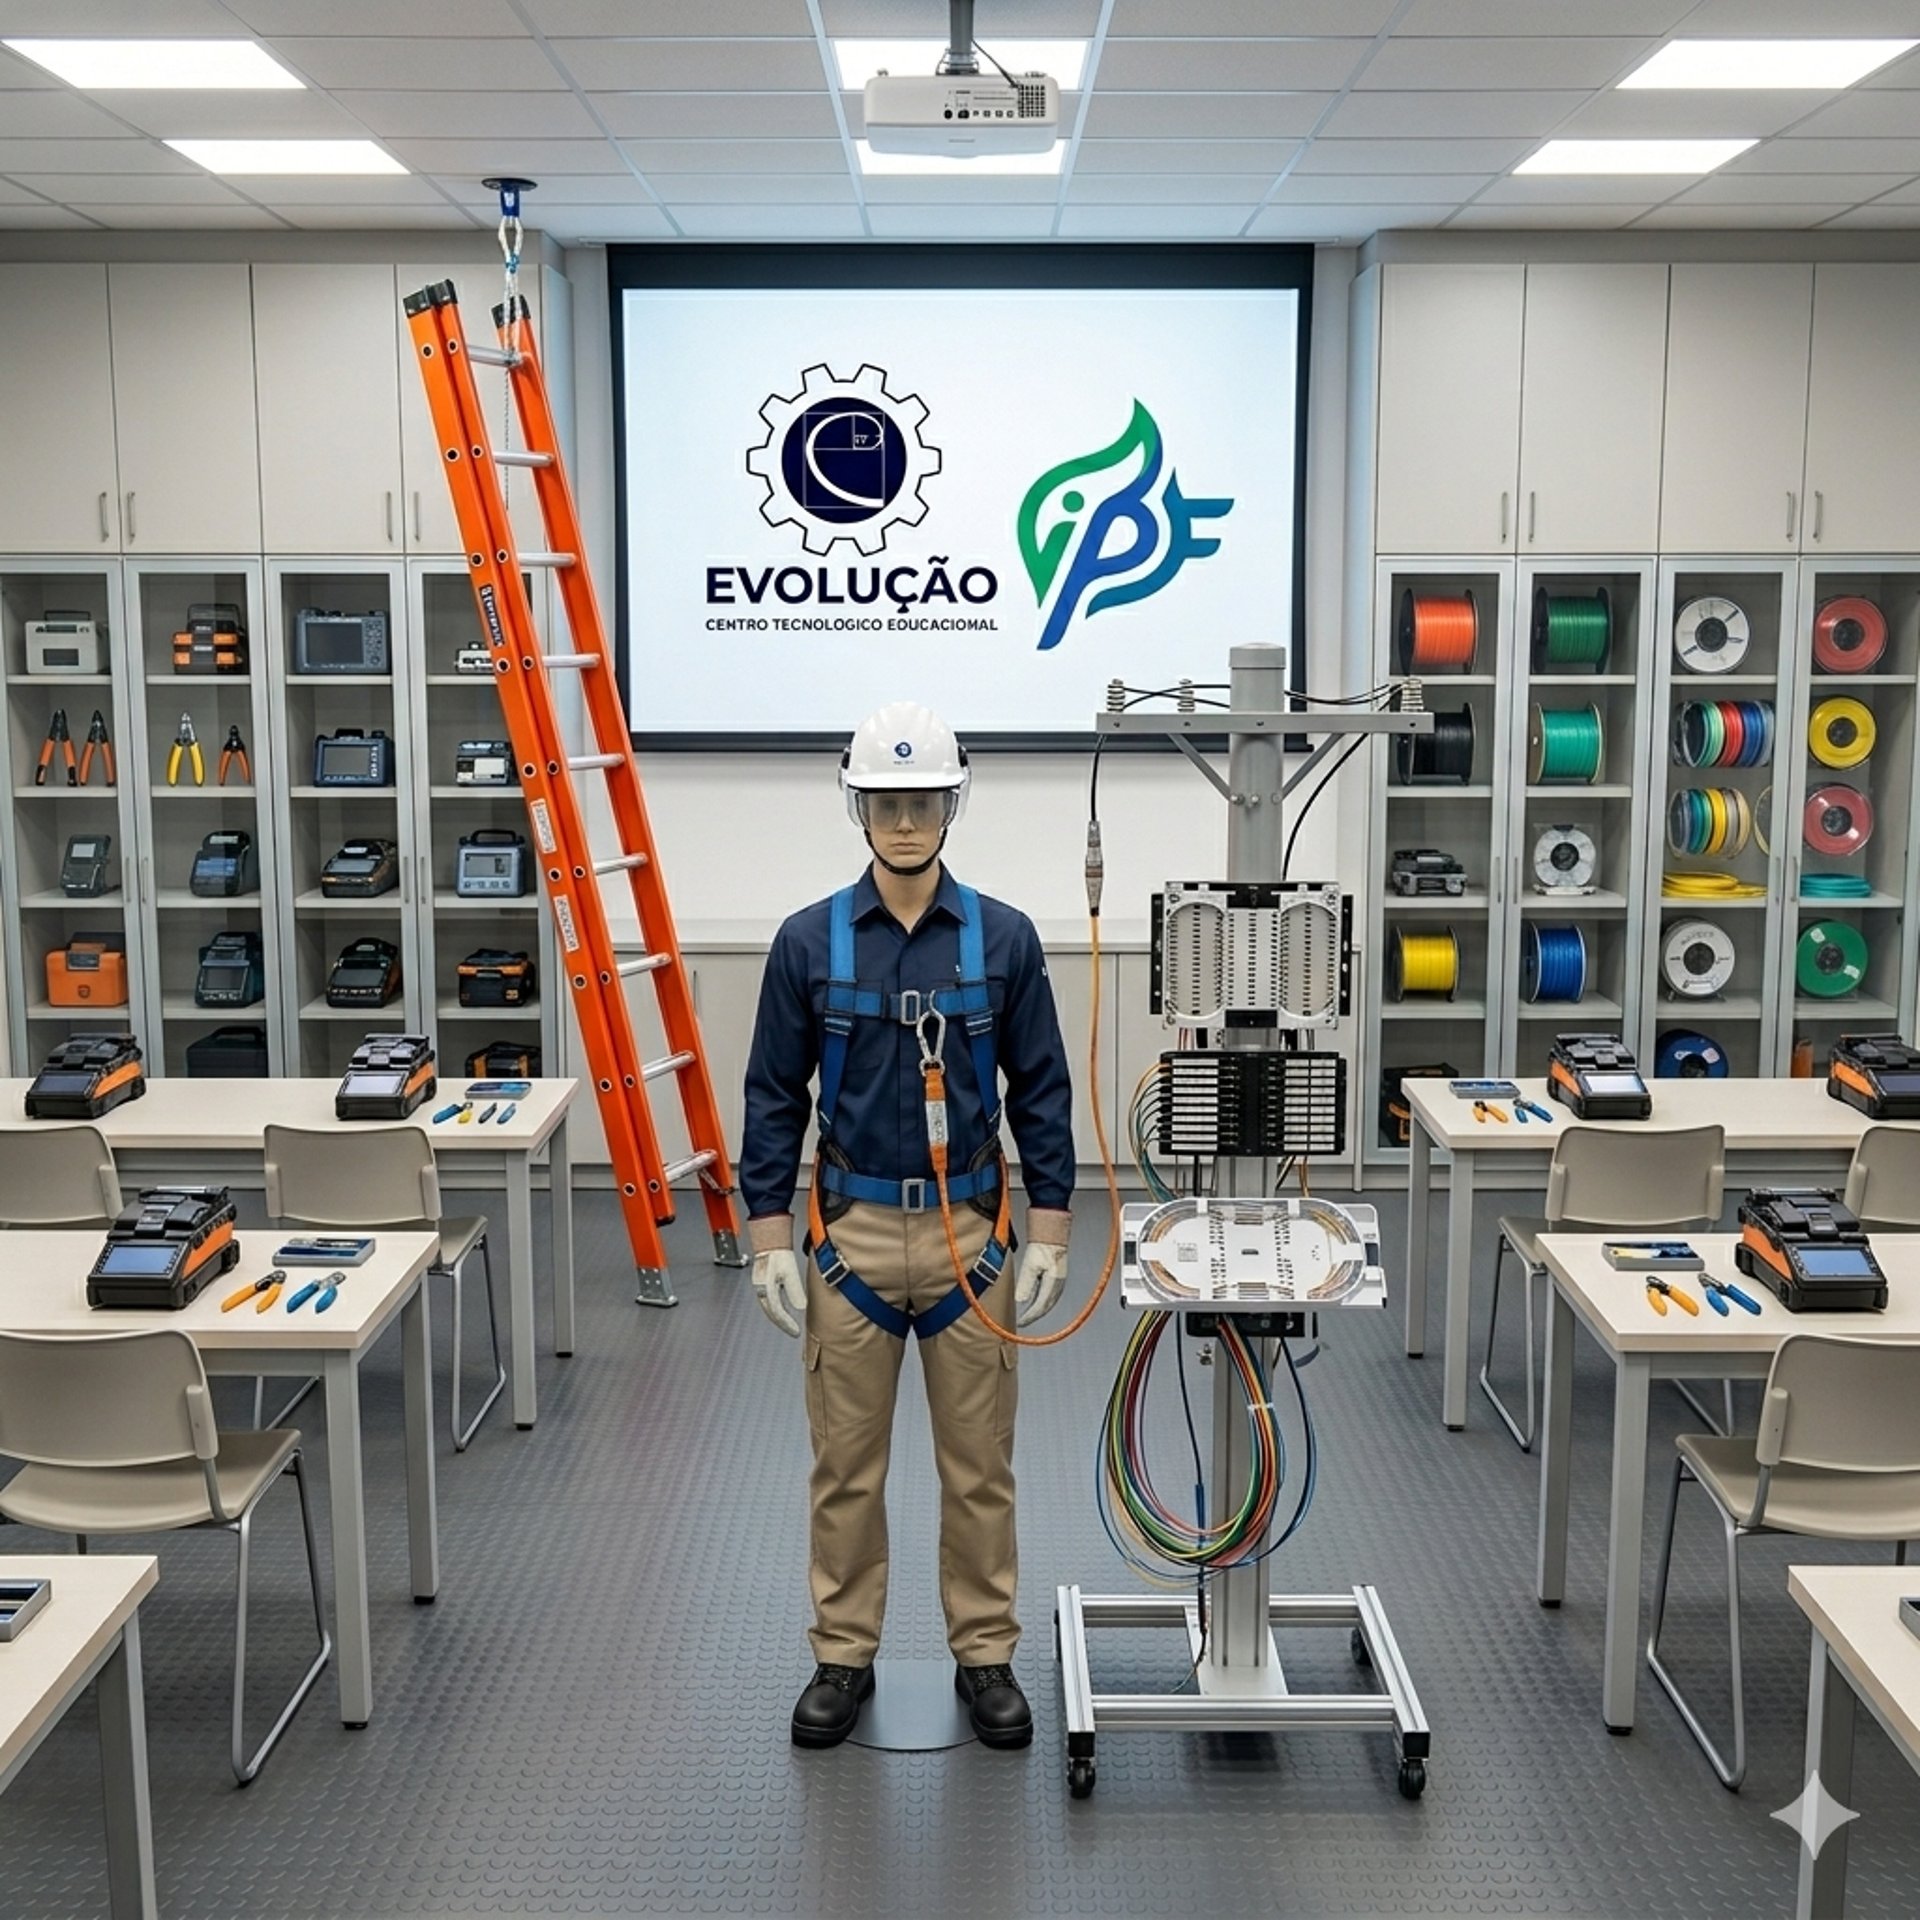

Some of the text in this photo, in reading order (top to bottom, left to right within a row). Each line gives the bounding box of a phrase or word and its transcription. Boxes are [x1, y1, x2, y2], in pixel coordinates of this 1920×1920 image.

[706, 556, 998, 614] EVOLUÇÃO
[705, 618, 769, 631] CENTRO
[772, 618, 883, 631] TECNOLOGICO
